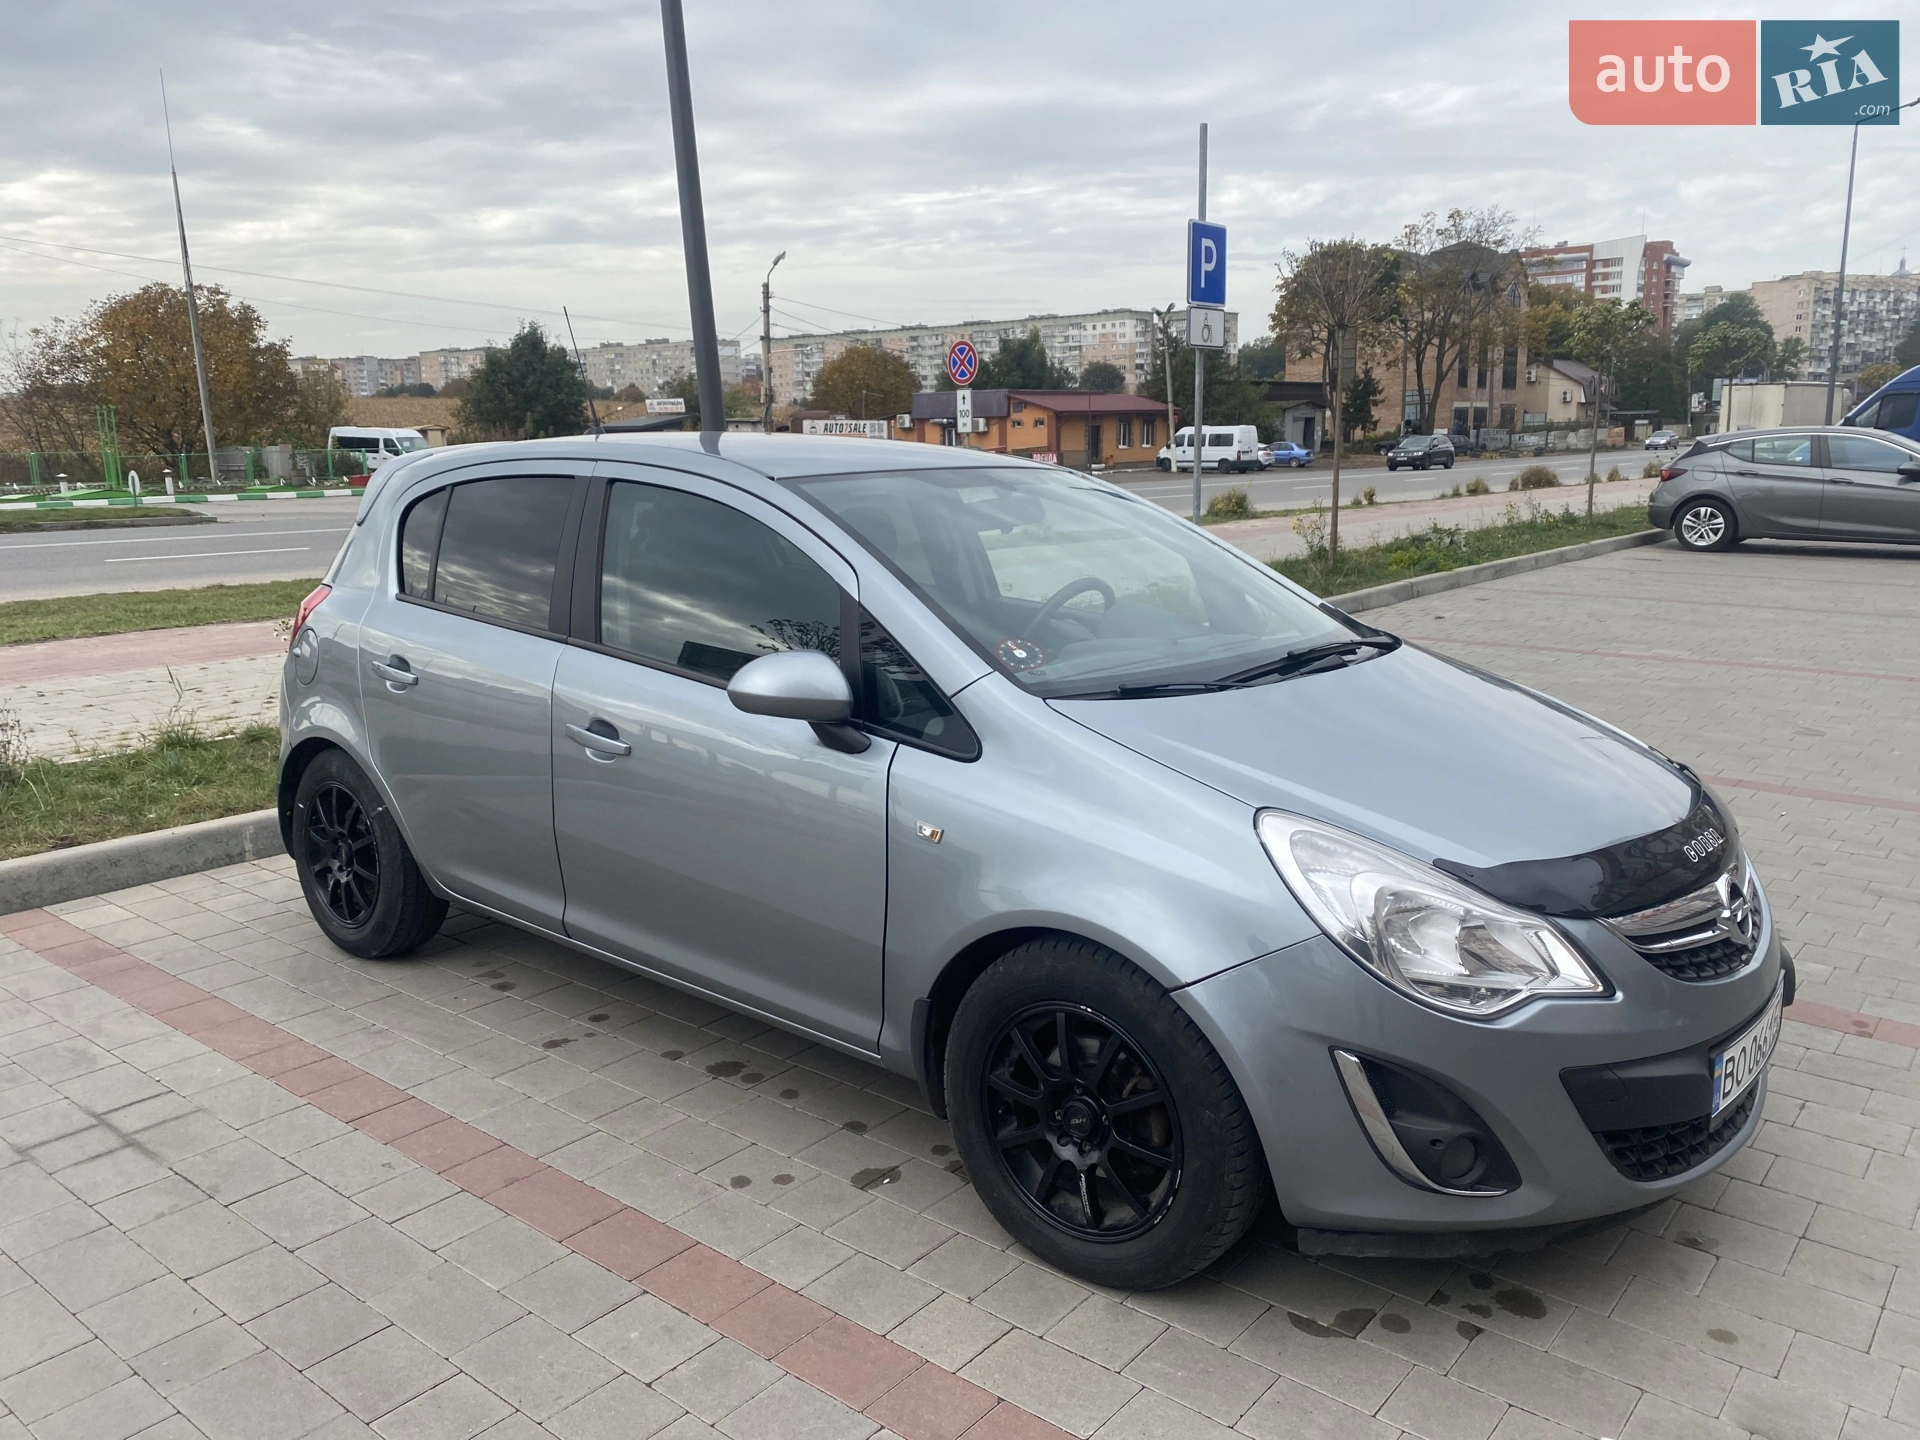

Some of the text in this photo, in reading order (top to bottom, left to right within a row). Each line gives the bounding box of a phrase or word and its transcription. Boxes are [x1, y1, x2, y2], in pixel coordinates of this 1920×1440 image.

[1200, 237, 1217, 289] P
[958, 409, 970, 418] 100
[1683, 828, 1724, 863] CORSA
